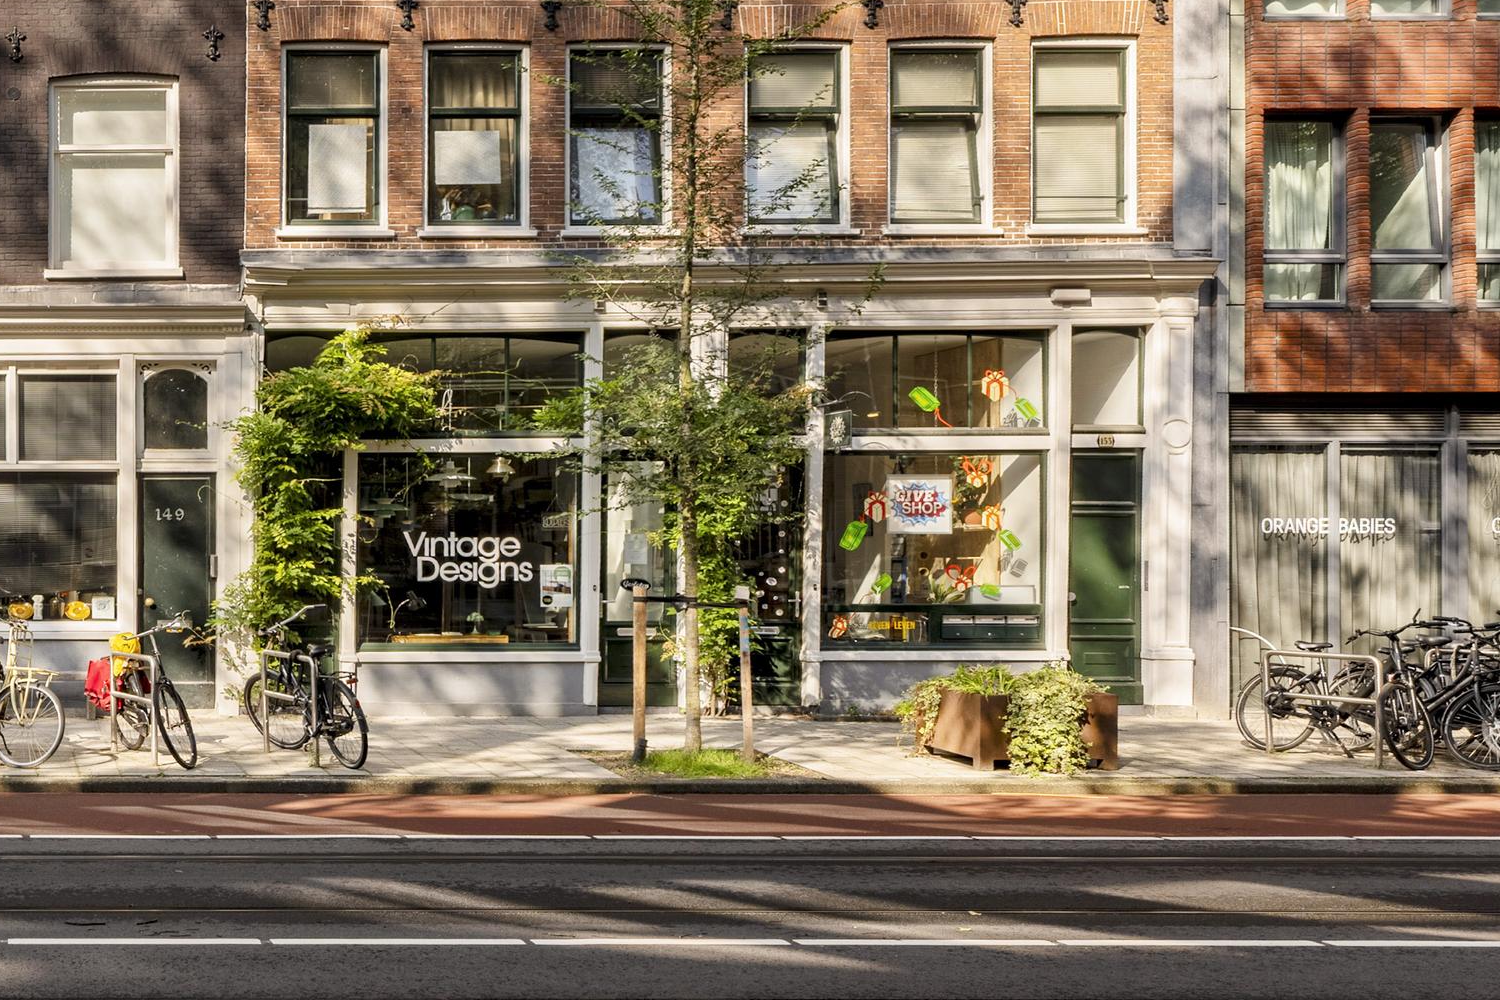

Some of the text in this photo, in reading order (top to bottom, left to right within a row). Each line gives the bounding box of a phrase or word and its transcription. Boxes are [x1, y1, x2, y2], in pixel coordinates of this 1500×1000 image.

[895, 490, 934, 502] GIVE
[155, 508, 185, 521] 149
[902, 501, 942, 514] SHOP
[1261, 517, 1397, 535] ORANGE BABIES
[403, 531, 521, 563] Vintage
[417, 556, 534, 589] Designs
